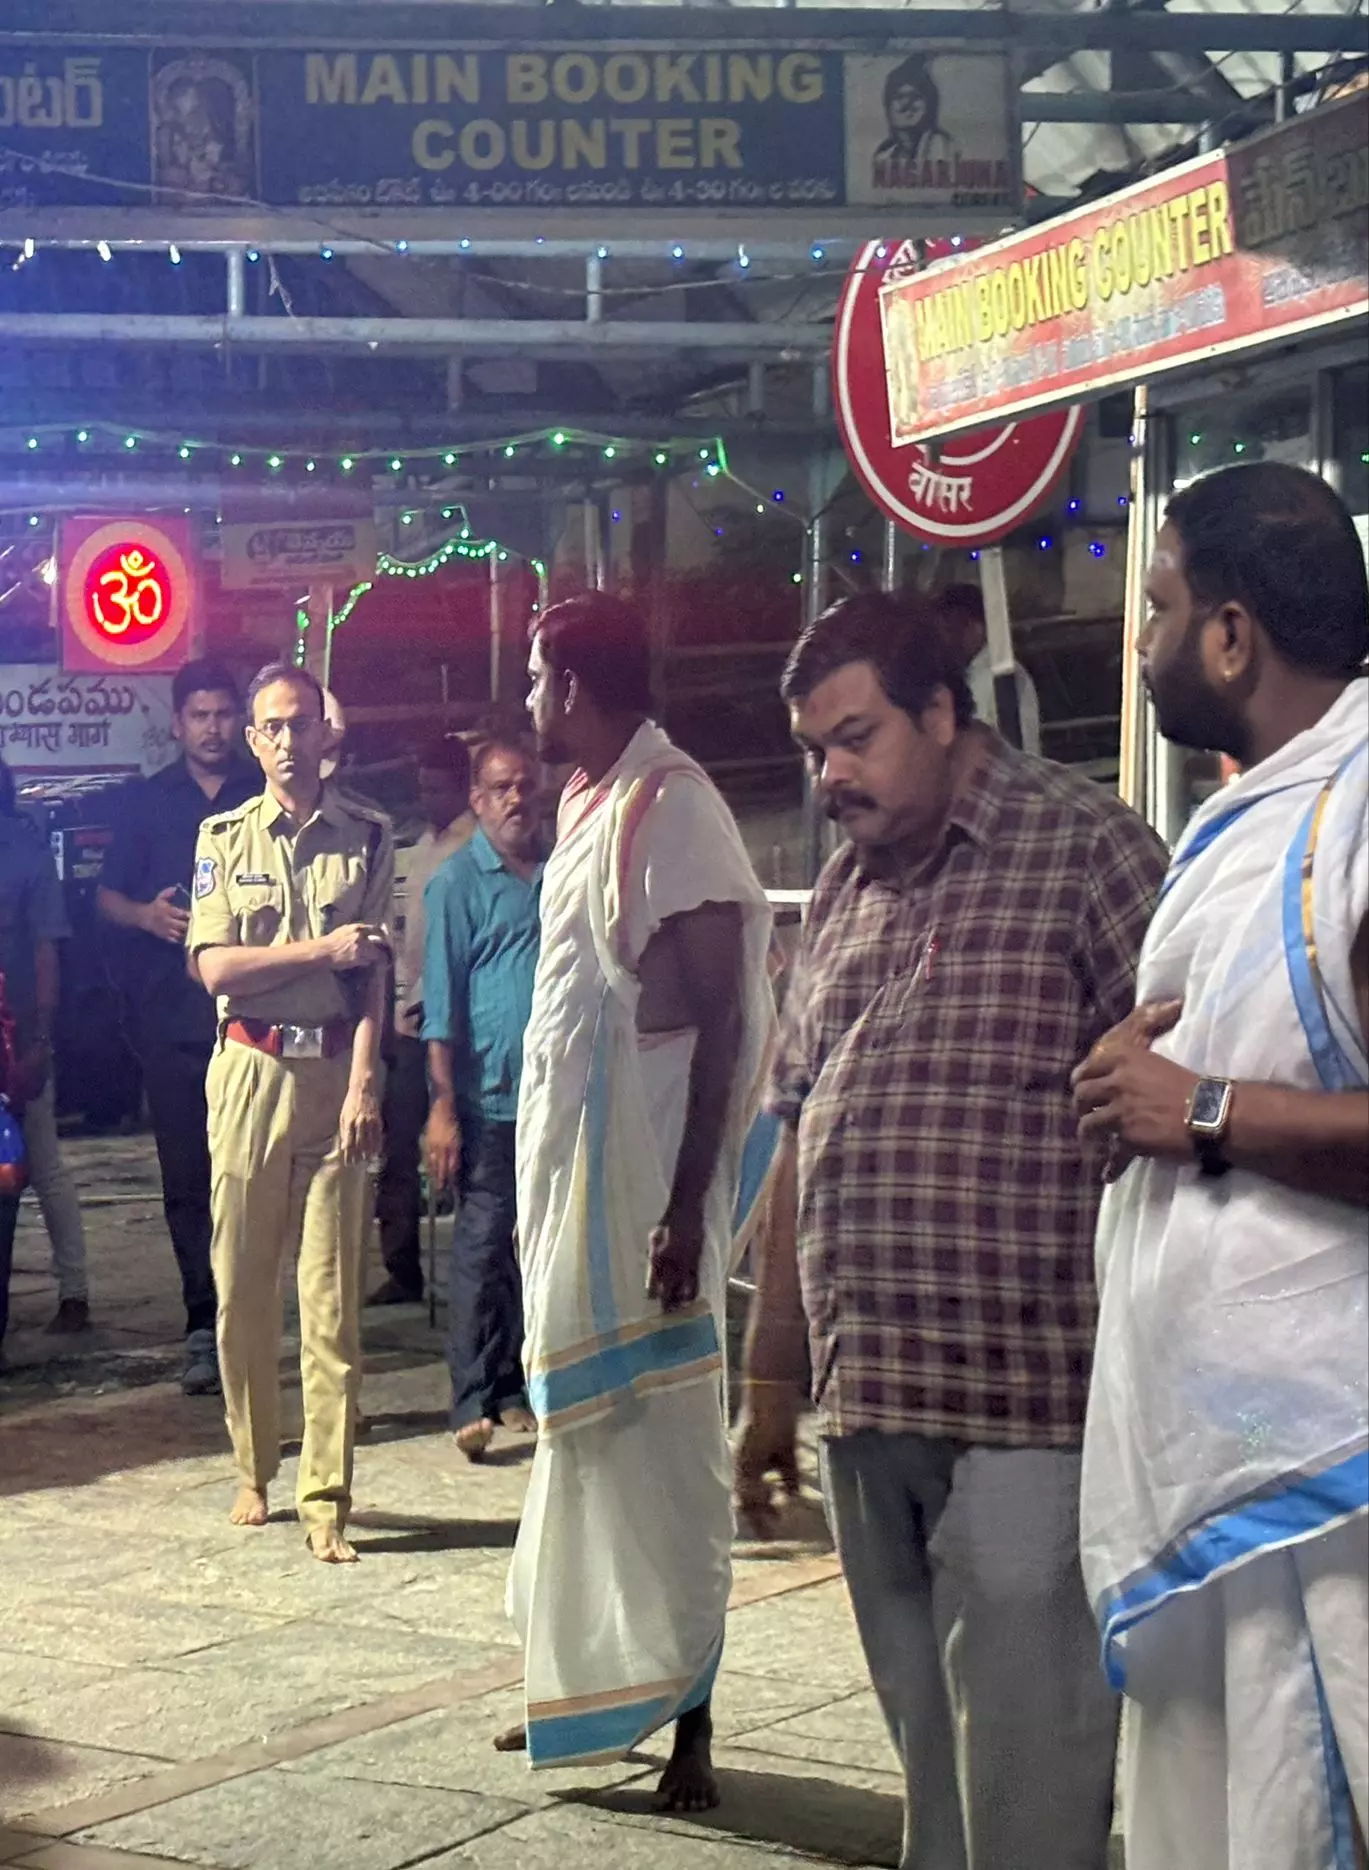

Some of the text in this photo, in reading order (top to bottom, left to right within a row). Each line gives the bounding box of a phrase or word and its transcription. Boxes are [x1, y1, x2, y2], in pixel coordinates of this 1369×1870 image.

[305, 52, 825, 104] MAIN BOOKING
[412, 118, 744, 170] COUNTER
[915, 281, 975, 362] MAIN
[974, 237, 1088, 343] BOOKING
[1092, 180, 1235, 301] COUNTER
